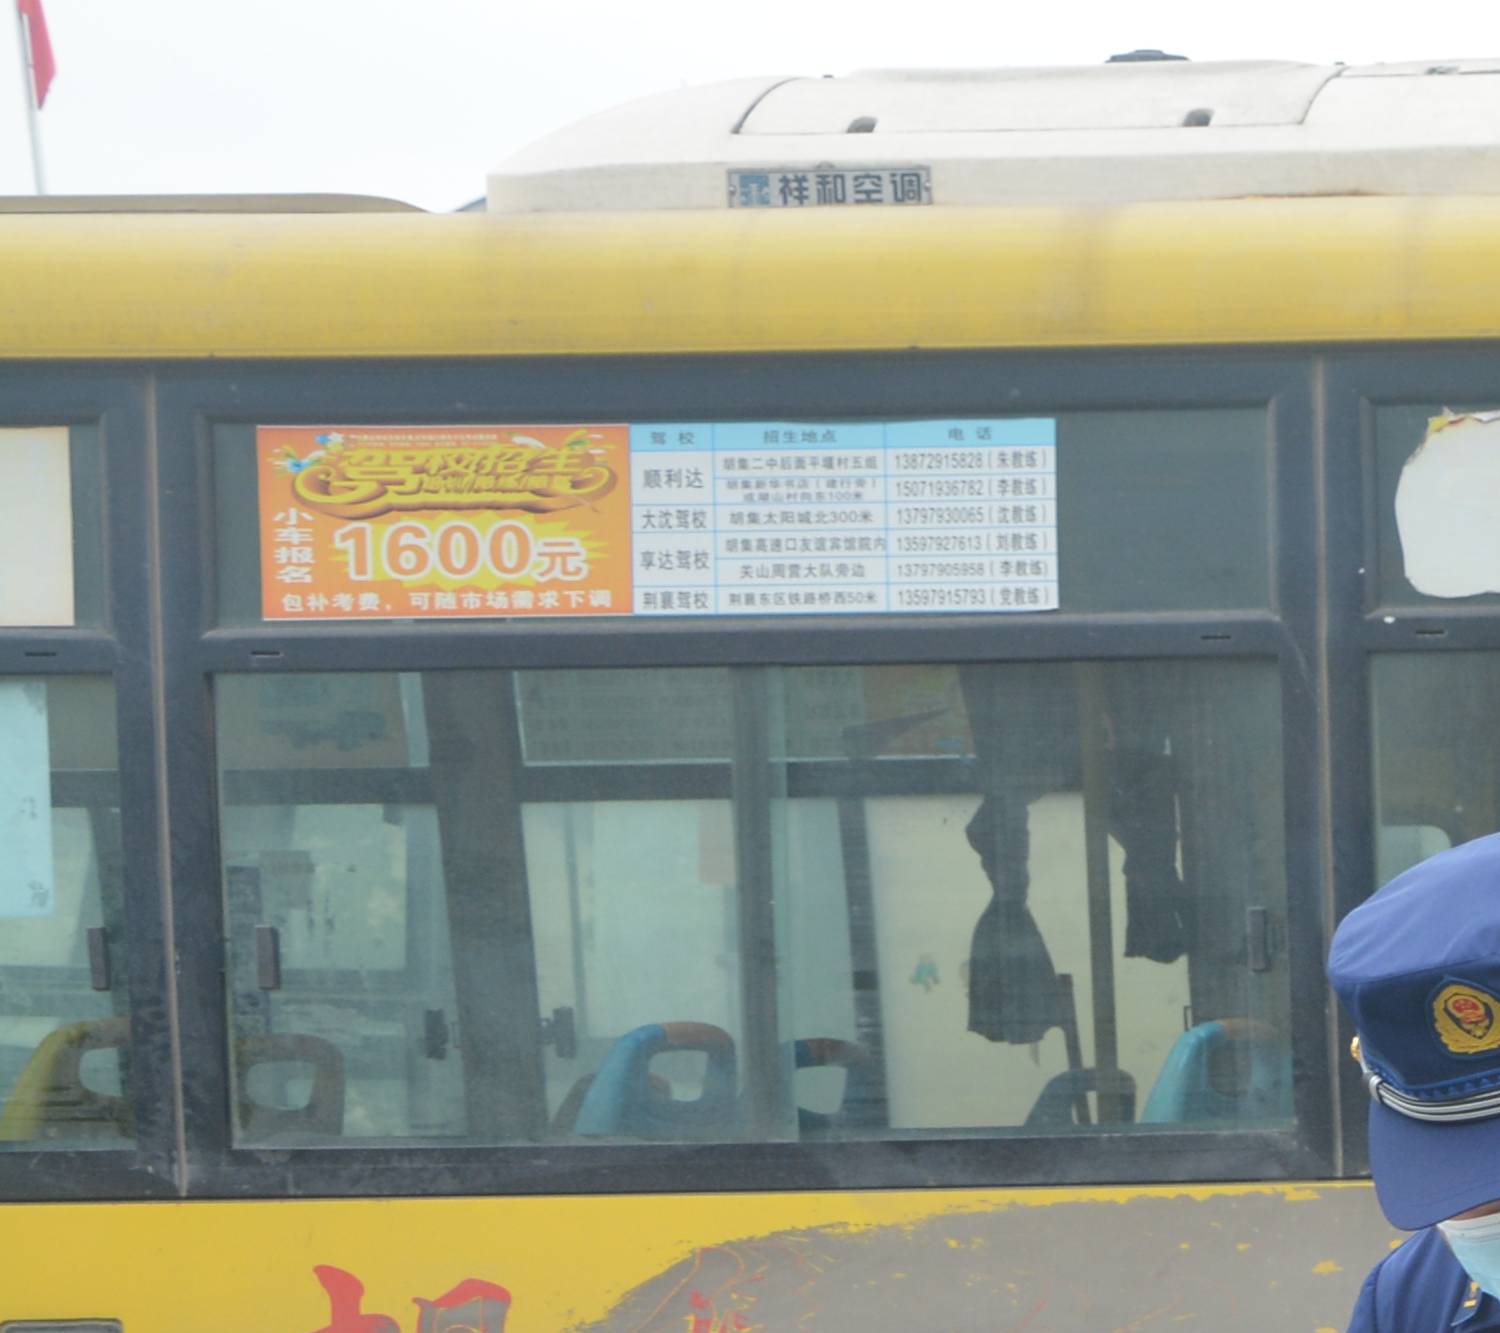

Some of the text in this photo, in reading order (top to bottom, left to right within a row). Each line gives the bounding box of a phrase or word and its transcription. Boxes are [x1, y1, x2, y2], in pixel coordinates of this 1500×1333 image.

[778, 173, 922, 206] 祥和空调
[763, 429, 838, 444] 招生地点
[643, 468, 704, 489] 顺利达
[273, 507, 316, 583] 小车报名
[334, 519, 589, 582] 1600元
[640, 550, 711, 570] 享达驾校
[642, 591, 709, 610] 荆襄驾校
